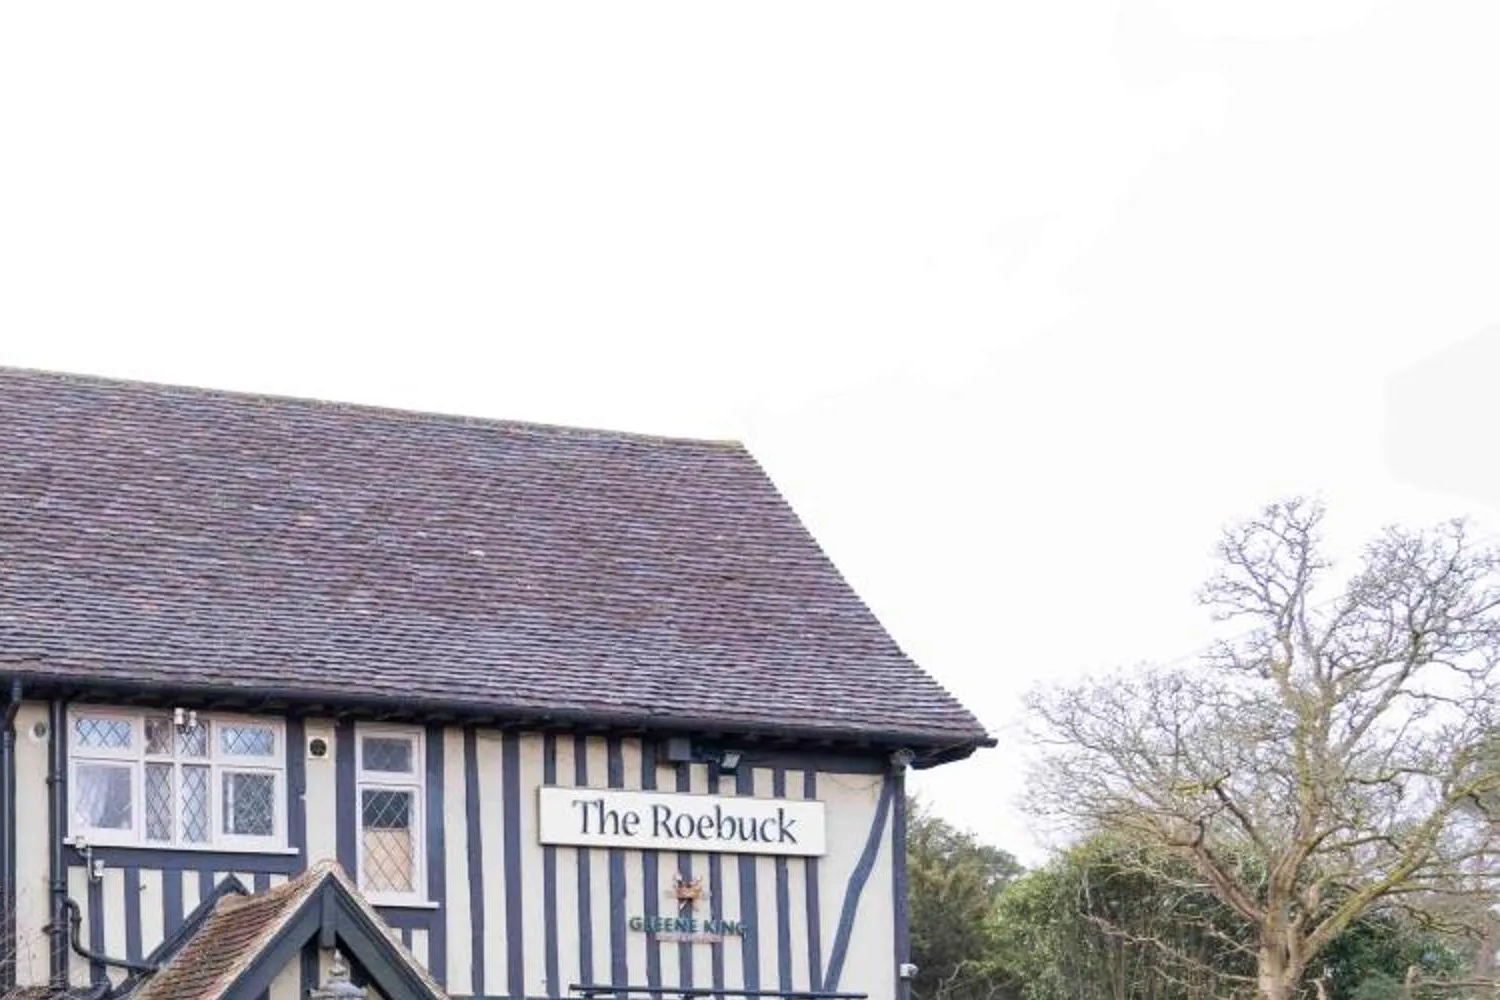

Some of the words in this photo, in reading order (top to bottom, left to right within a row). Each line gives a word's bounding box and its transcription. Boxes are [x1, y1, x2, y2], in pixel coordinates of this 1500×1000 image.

[571, 798, 641, 837] The
[651, 803, 798, 844] Roebuck
[628, 916, 701, 933] GREENE
[703, 919, 749, 939] KING
